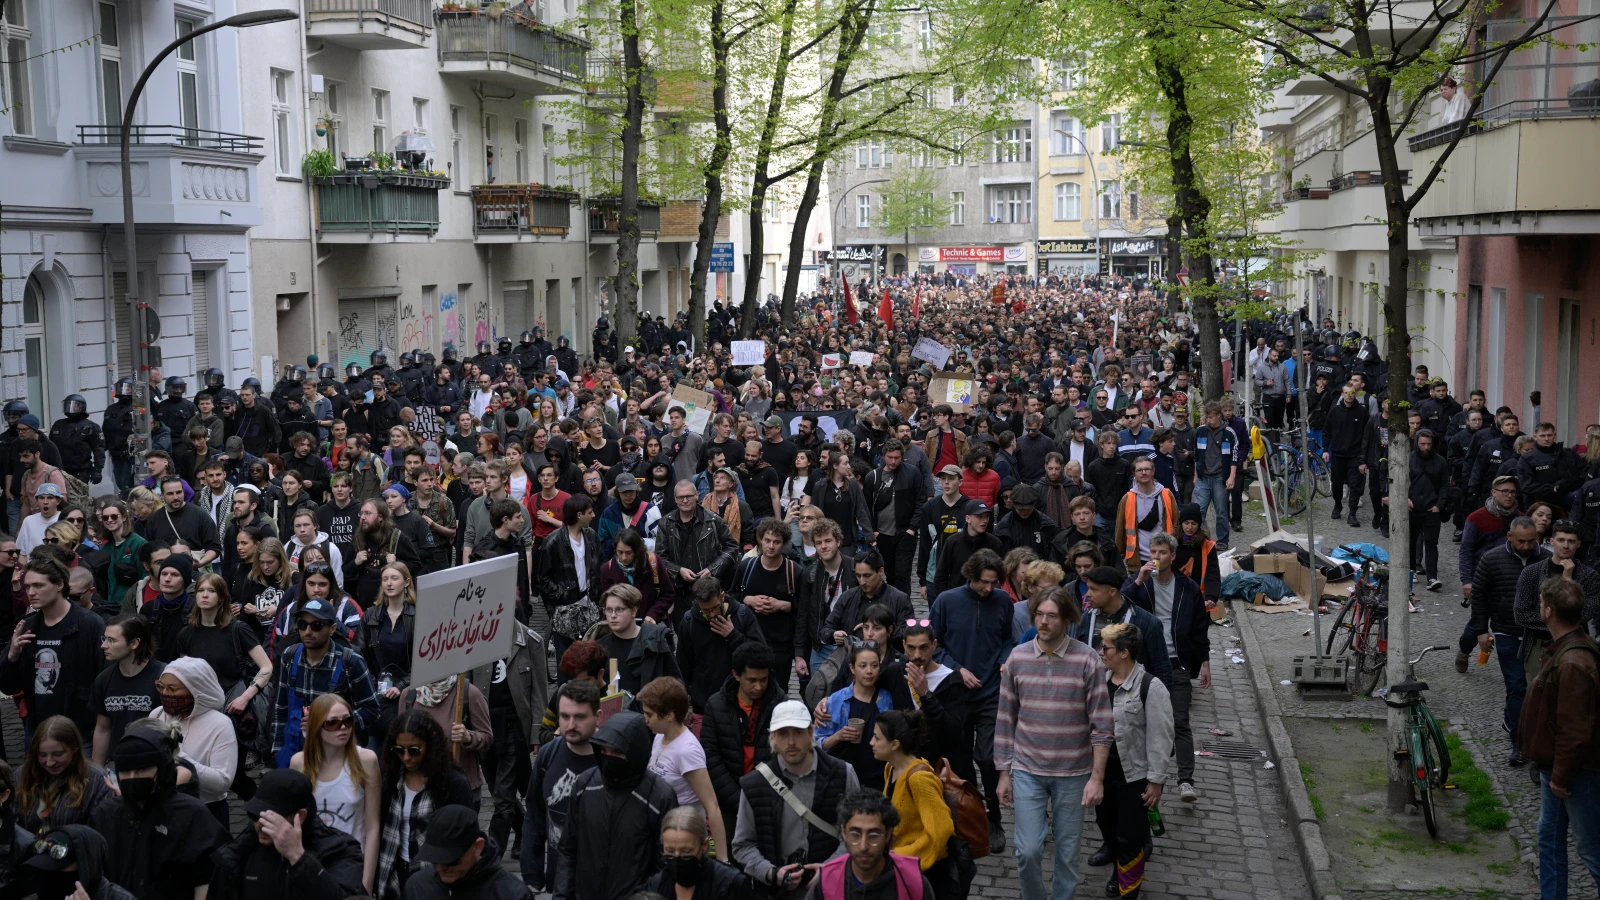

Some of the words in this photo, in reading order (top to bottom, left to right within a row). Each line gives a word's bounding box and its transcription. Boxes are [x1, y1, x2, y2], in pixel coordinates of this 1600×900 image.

[942, 248, 968, 256] Technic
[1052, 241, 1083, 253] Ishtar
[1112, 241, 1127, 254] ASIA
[1135, 240, 1154, 253] CAFE
[416, 406, 436, 416] EAT
[416, 414, 438, 423] THE
[422, 431, 436, 440] OF
[332, 516, 351, 525] RAP
[330, 525, 353, 534] ÜBER
[331, 534, 353, 544] HASS
[454, 578, 473, 617] نام
[475, 585, 486, 604] به
